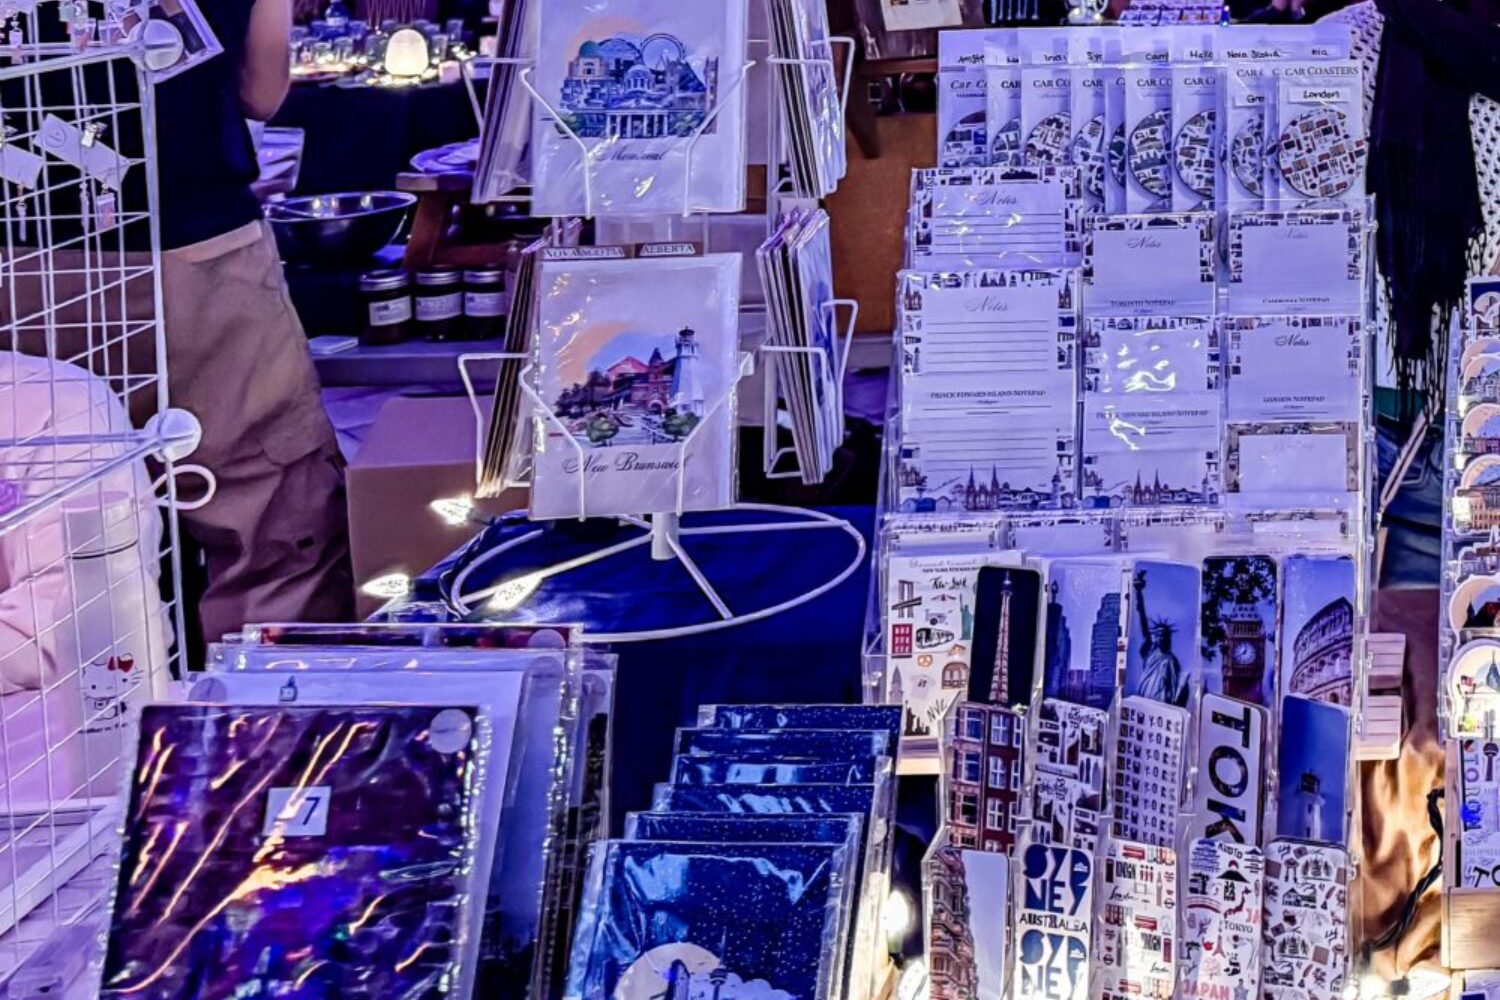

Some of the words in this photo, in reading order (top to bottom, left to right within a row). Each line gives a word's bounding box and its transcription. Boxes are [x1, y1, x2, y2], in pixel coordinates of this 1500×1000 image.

[1284, 67, 1306, 78] CAR
[1306, 66, 1360, 77] COASTERS
[1032, 78, 1054, 89] CAR
[1136, 77, 1158, 88] CAR
[1184, 77, 1208, 87] CAR
[1302, 88, 1340, 100] London
[641, 242, 695, 255] ALBERTA
[1273, 332, 1312, 347] Notes
[1023, 843, 1091, 887] SYD
[1024, 879, 1088, 916] NEY
[1019, 912, 1089, 934] AUSTRALIA
[1223, 919, 1254, 934] TOKYO
[1182, 977, 1230, 1000] JAPAN
